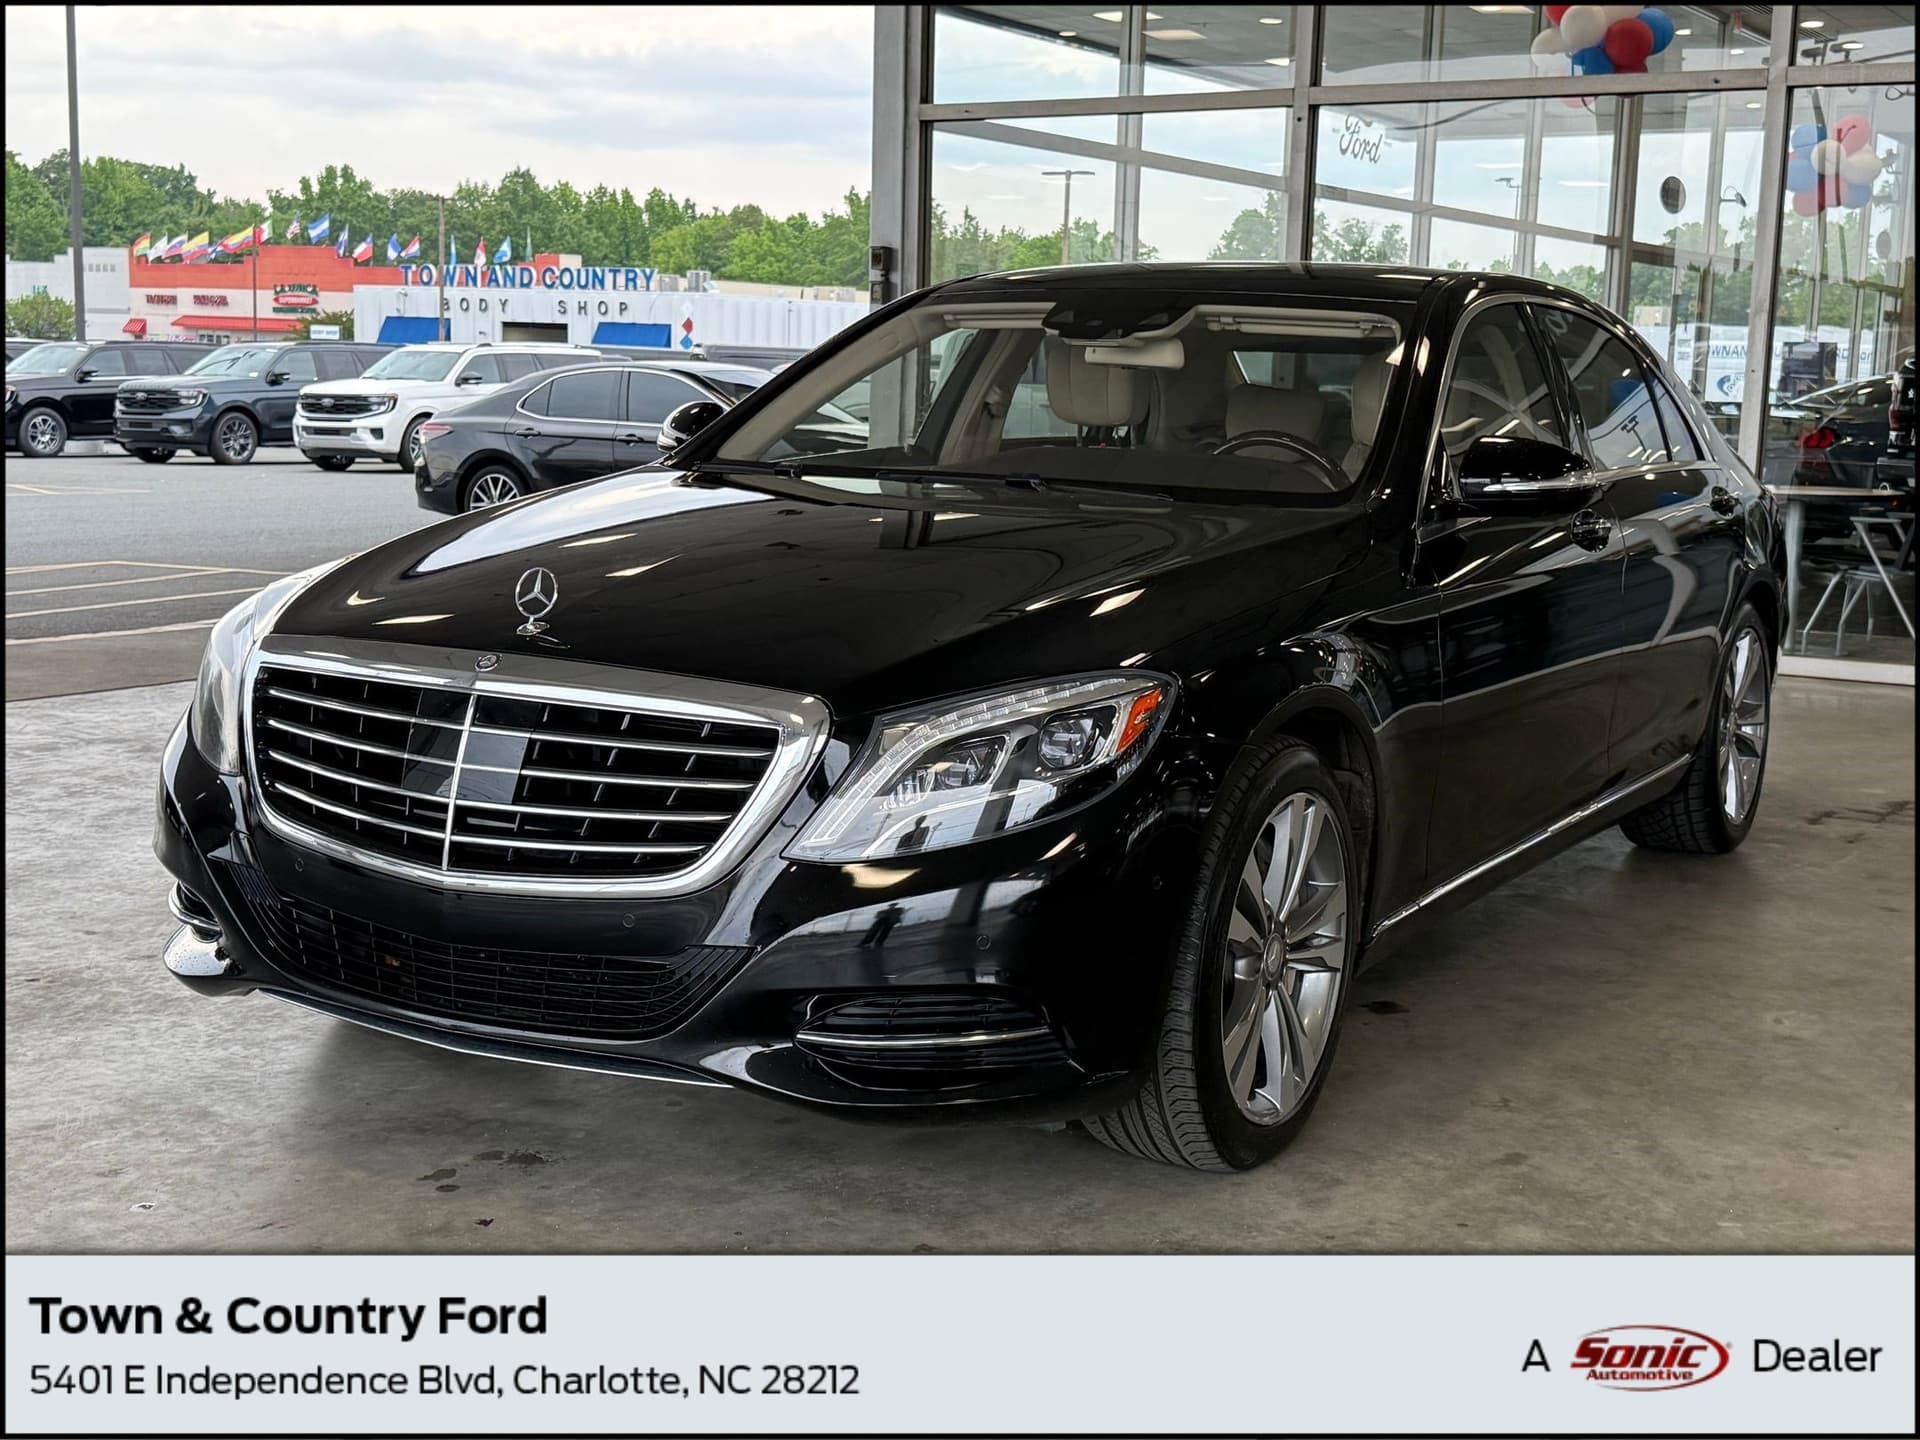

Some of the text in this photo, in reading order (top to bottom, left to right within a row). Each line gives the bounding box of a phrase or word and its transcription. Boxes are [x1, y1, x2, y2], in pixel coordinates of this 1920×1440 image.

[1339, 112, 1383, 164] Ford
[401, 265, 657, 291] TOWN AND COUNTRY
[557, 299, 628, 316] SHOP
